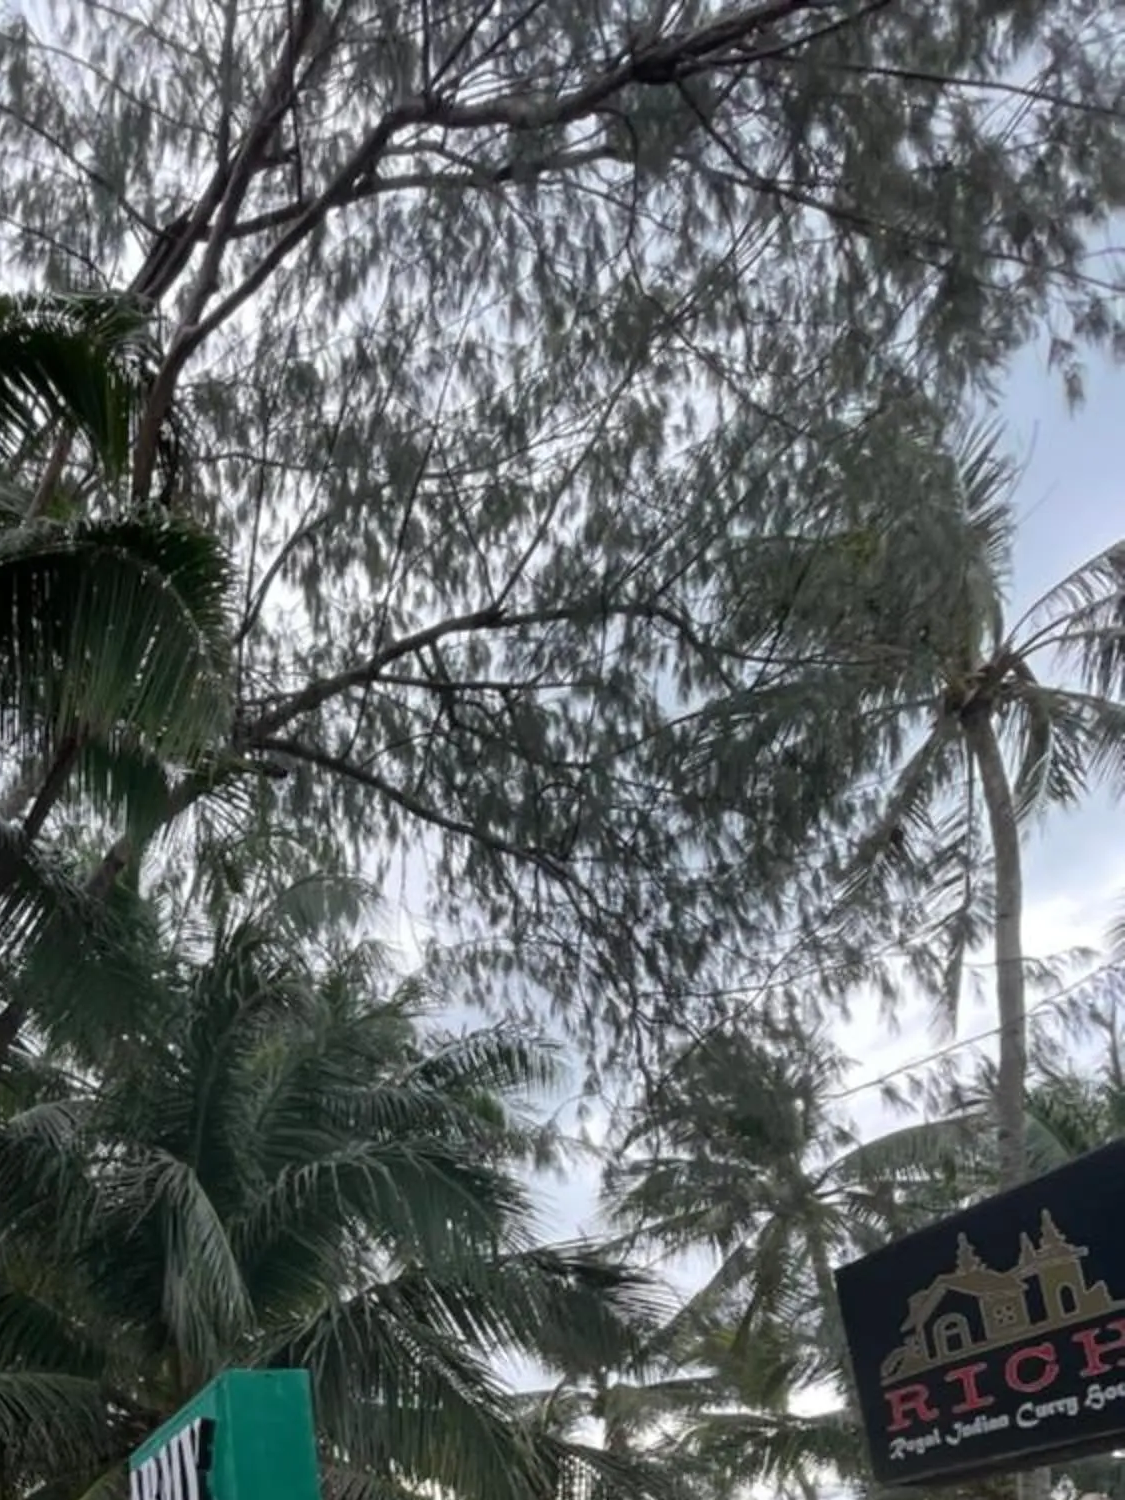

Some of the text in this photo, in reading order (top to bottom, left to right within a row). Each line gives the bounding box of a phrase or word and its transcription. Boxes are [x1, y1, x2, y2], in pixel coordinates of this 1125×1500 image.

[890, 1427, 941, 1460] Royal
[945, 1414, 1010, 1446] Indian
[1016, 1396, 1079, 1428] Curry
